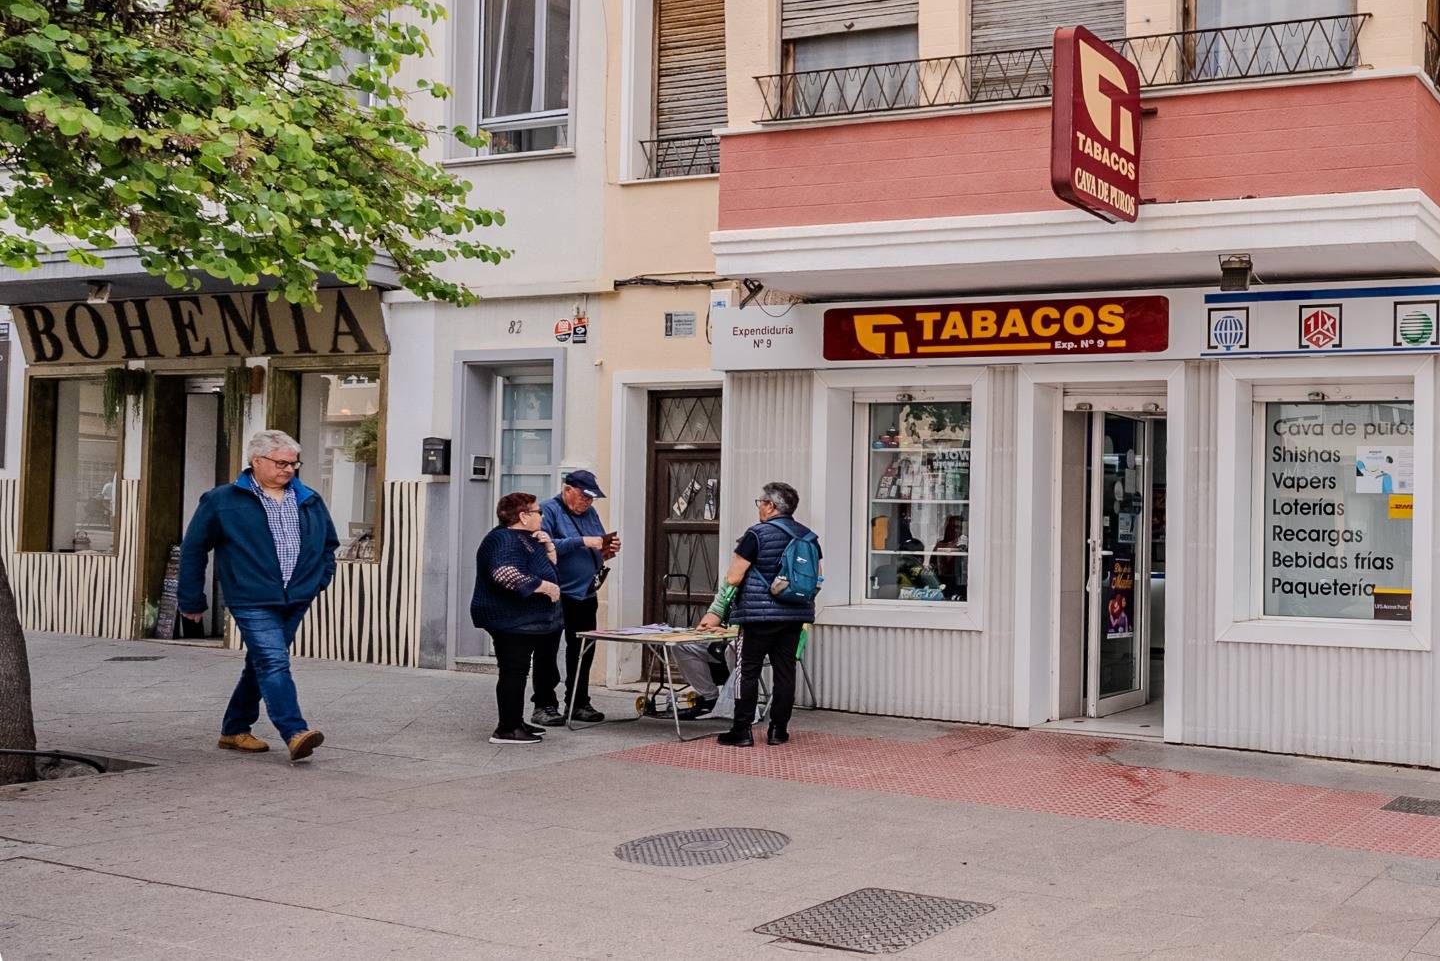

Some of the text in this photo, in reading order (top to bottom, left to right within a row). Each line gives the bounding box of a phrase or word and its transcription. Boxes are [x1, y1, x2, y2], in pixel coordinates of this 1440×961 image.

[1077, 131, 1135, 180] TABACOS
[1075, 167, 1135, 216] CAVA DE PUROS
[19, 290, 378, 363] BOHEMIA
[508, 320, 523, 334] 82
[732, 325, 794, 337] Expendiduría
[915, 304, 1126, 340] TABACOS
[753, 339, 772, 348] Nº 9
[1054, 339, 1105, 350] Exp. Nº 9
[1273, 419, 1324, 436] Cava
[1331, 419, 1357, 436] de
[1272, 446, 1341, 463] Shishas
[1272, 472, 1336, 492] Vapers
[1272, 498, 1344, 516] Loterías
[1272, 525, 1363, 547] Recargas
[1272, 551, 1394, 570] Bebidas frías
[1271, 577, 1376, 598] Paquetería
